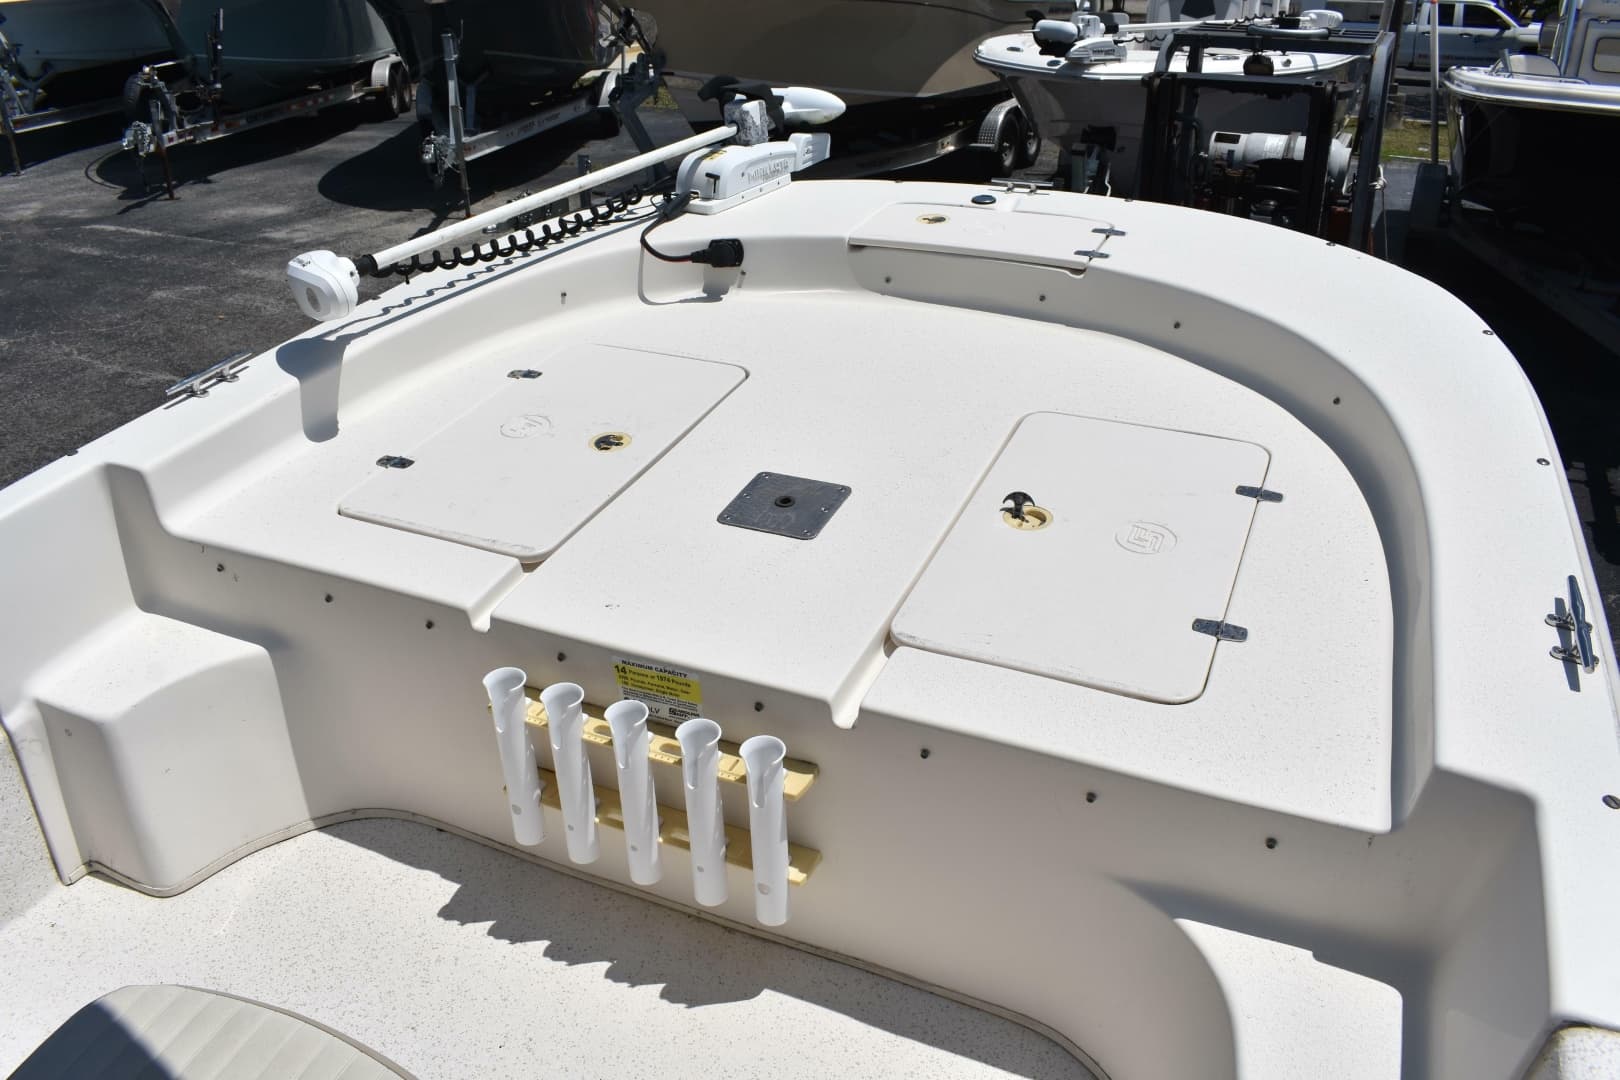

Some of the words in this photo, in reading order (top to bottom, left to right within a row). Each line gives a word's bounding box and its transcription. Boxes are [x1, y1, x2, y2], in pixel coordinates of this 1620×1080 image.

[614, 664, 627, 674] 14
[622, 660, 653, 670] MAXIMUM
[654, 667, 688, 678] CAPACITY
